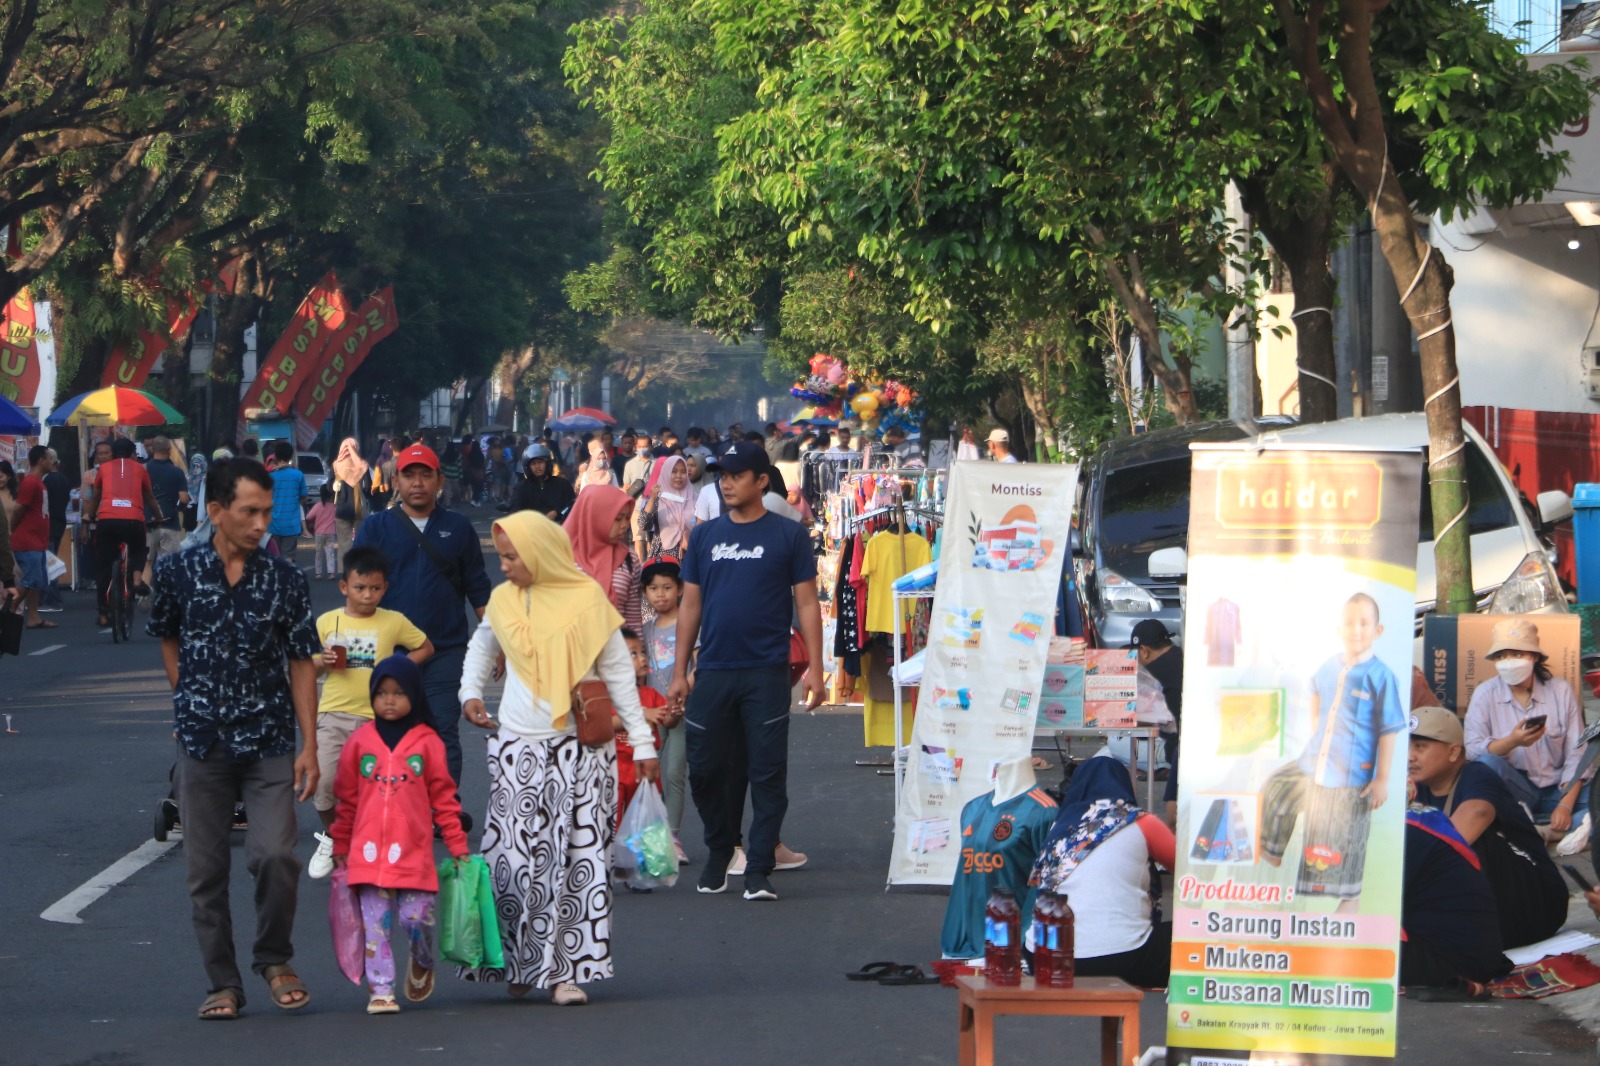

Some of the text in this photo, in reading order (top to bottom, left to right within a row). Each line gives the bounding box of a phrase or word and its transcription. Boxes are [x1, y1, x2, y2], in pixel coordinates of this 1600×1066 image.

[258, 355, 297, 409] BUD
[991, 483, 1042, 496] Montiss
[1238, 479, 1359, 510] haidar
[1434, 649, 1447, 706] ONTISS
[1465, 650, 1475, 682] Tissue
[1180, 876, 1281, 902] Produsen
[1207, 912, 1281, 938] Sarung
[1290, 915, 1355, 937] Instan
[1206, 947, 1289, 970] Mukena
[1204, 980, 1281, 1003] Busana
[1291, 983, 1370, 1007] Muslim
[1197, 1019, 1226, 1028] Bakalan
[1229, 1020, 1259, 1030] Krapyak
[1303, 1023, 1326, 1032] Kudus
[1334, 1025, 1355, 1034] Jawa
[1357, 1026, 1385, 1036] Tengah
